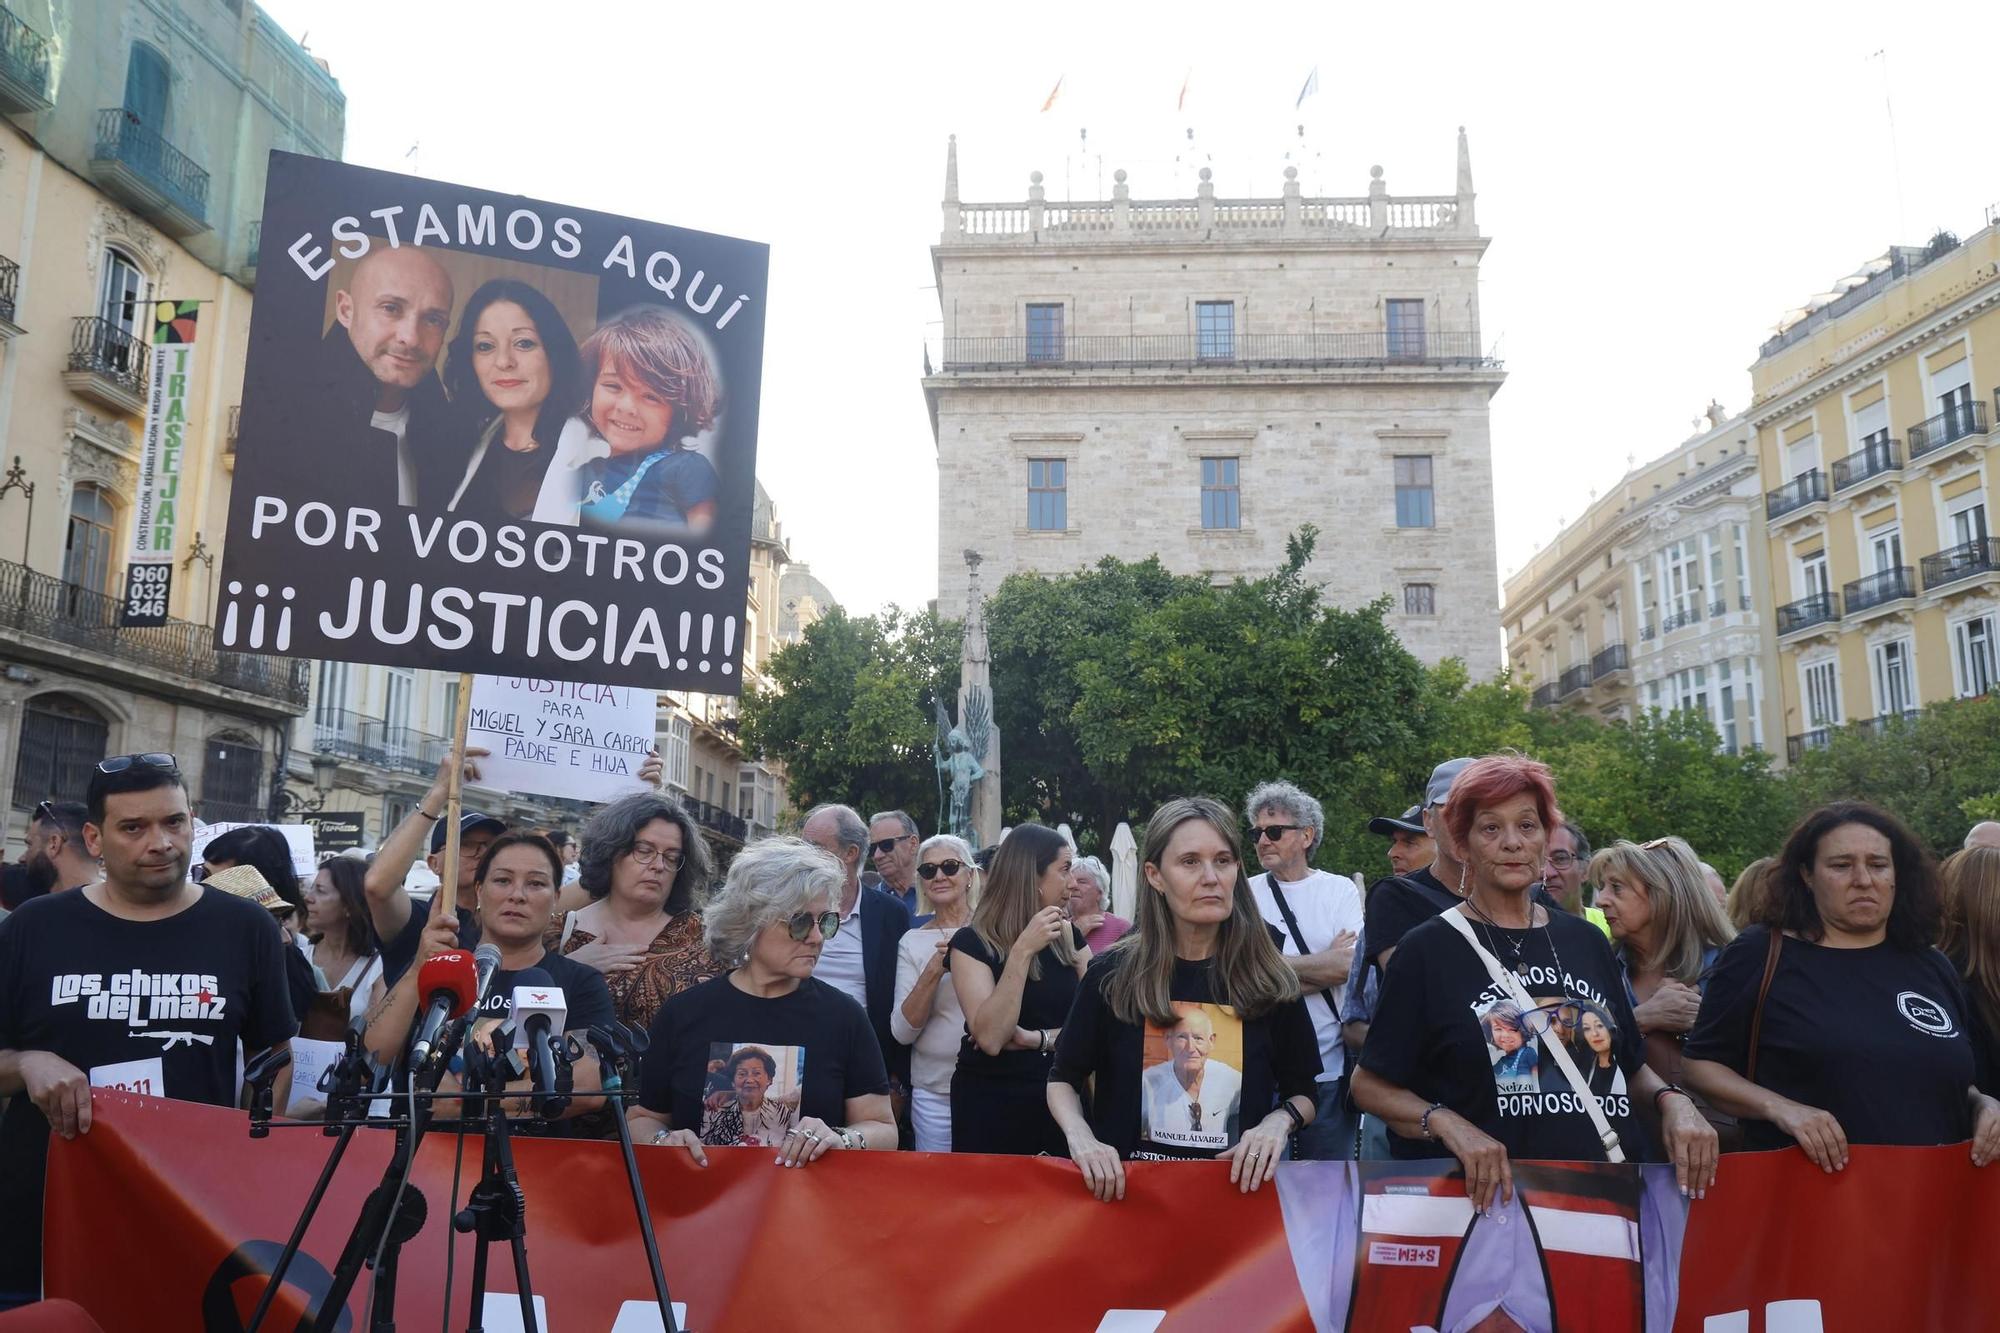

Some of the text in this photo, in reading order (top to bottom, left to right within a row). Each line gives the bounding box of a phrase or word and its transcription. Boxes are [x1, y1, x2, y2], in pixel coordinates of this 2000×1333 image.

[288, 203, 750, 330] ESTAMOS AQUÍ
[154, 350, 166, 388] AMBIENTE
[152, 389, 162, 414] MEDIO
[153, 349, 189, 550] TRASEJAR
[251, 495, 725, 590] POR VOSOTROS
[131, 583, 167, 600] 032
[133, 566, 169, 582] 960
[127, 600, 165, 616] 346
[543, 700, 584, 720] PARA
[470, 708, 653, 755] MIGUEL Y SARA CARPIO
[505, 738, 628, 775] PADRE E HIJA
[1470, 966, 1558, 1010] ESTMOS
[1154, 1130, 1225, 1144] MANUEL ÁLVAREZ
